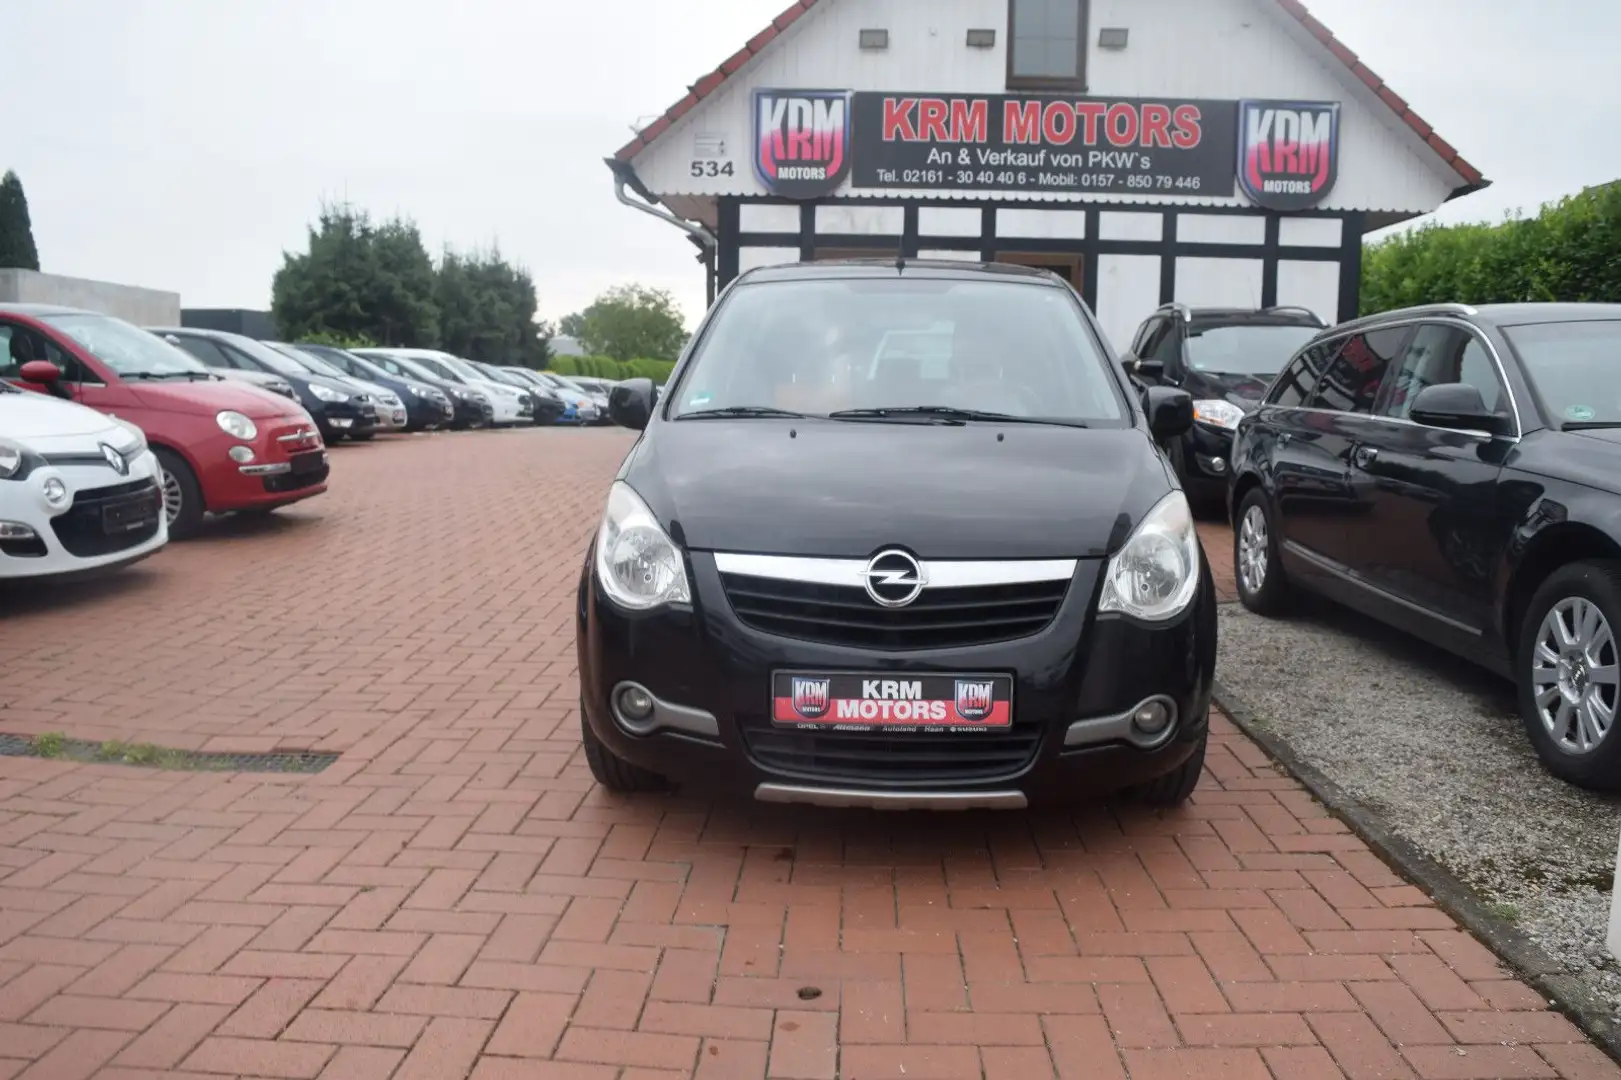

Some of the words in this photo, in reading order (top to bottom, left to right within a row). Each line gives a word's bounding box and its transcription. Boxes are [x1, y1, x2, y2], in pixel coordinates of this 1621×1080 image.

[761, 98, 845, 162] KRM
[882, 97, 988, 143] KRM
[1003, 100, 1201, 149] MOTORS
[1247, 109, 1331, 175] KRM
[927, 147, 952, 165] An
[957, 148, 971, 165] &
[976, 148, 1046, 166] Verkauf
[1050, 155, 1082, 168] von
[691, 160, 734, 177] 534
[778, 166, 826, 180] MOTORS
[876, 169, 899, 182] Tel.
[903, 169, 943, 183] 02161
[957, 170, 973, 184] 30
[976, 171, 994, 184] 40
[996, 171, 1014, 184] 40
[1017, 171, 1026, 185] 6
[1039, 172, 1078, 186] Mobil:
[1081, 174, 1114, 187] 0157
[1127, 175, 1152, 188] 850
[1156, 176, 1172, 189] 79
[1175, 176, 1200, 189] 446
[1263, 180, 1312, 194] MOTORS
[795, 681, 827, 706] KRM
[862, 680, 922, 700] KRM
[958, 683, 990, 708] KRM
[837, 700, 947, 720] MOTORS
